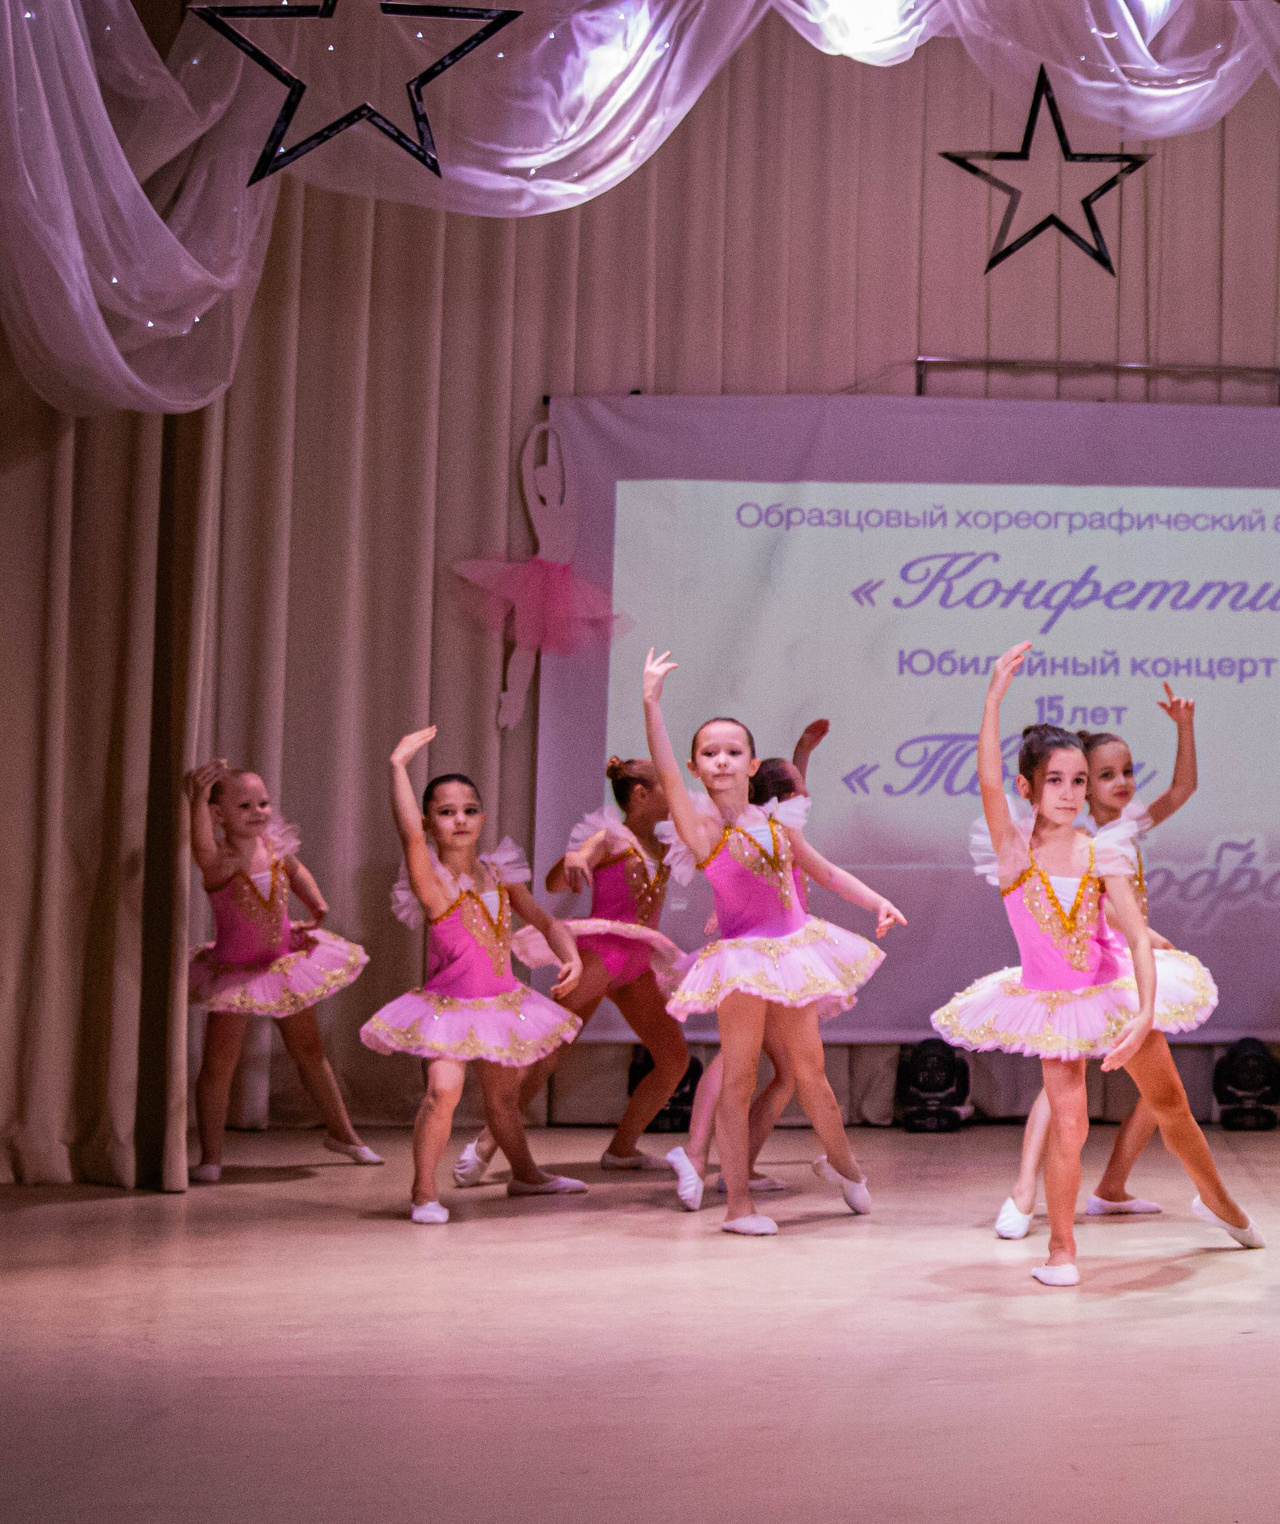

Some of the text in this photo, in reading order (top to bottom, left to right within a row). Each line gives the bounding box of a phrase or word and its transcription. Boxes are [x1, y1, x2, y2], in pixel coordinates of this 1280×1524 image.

[735, 502, 948, 533] Образцовый
[955, 507, 1267, 536] хореографический
[897, 649, 1279, 683] Юбилйный концерт
[1034, 695, 1129, 727] 15 лет
